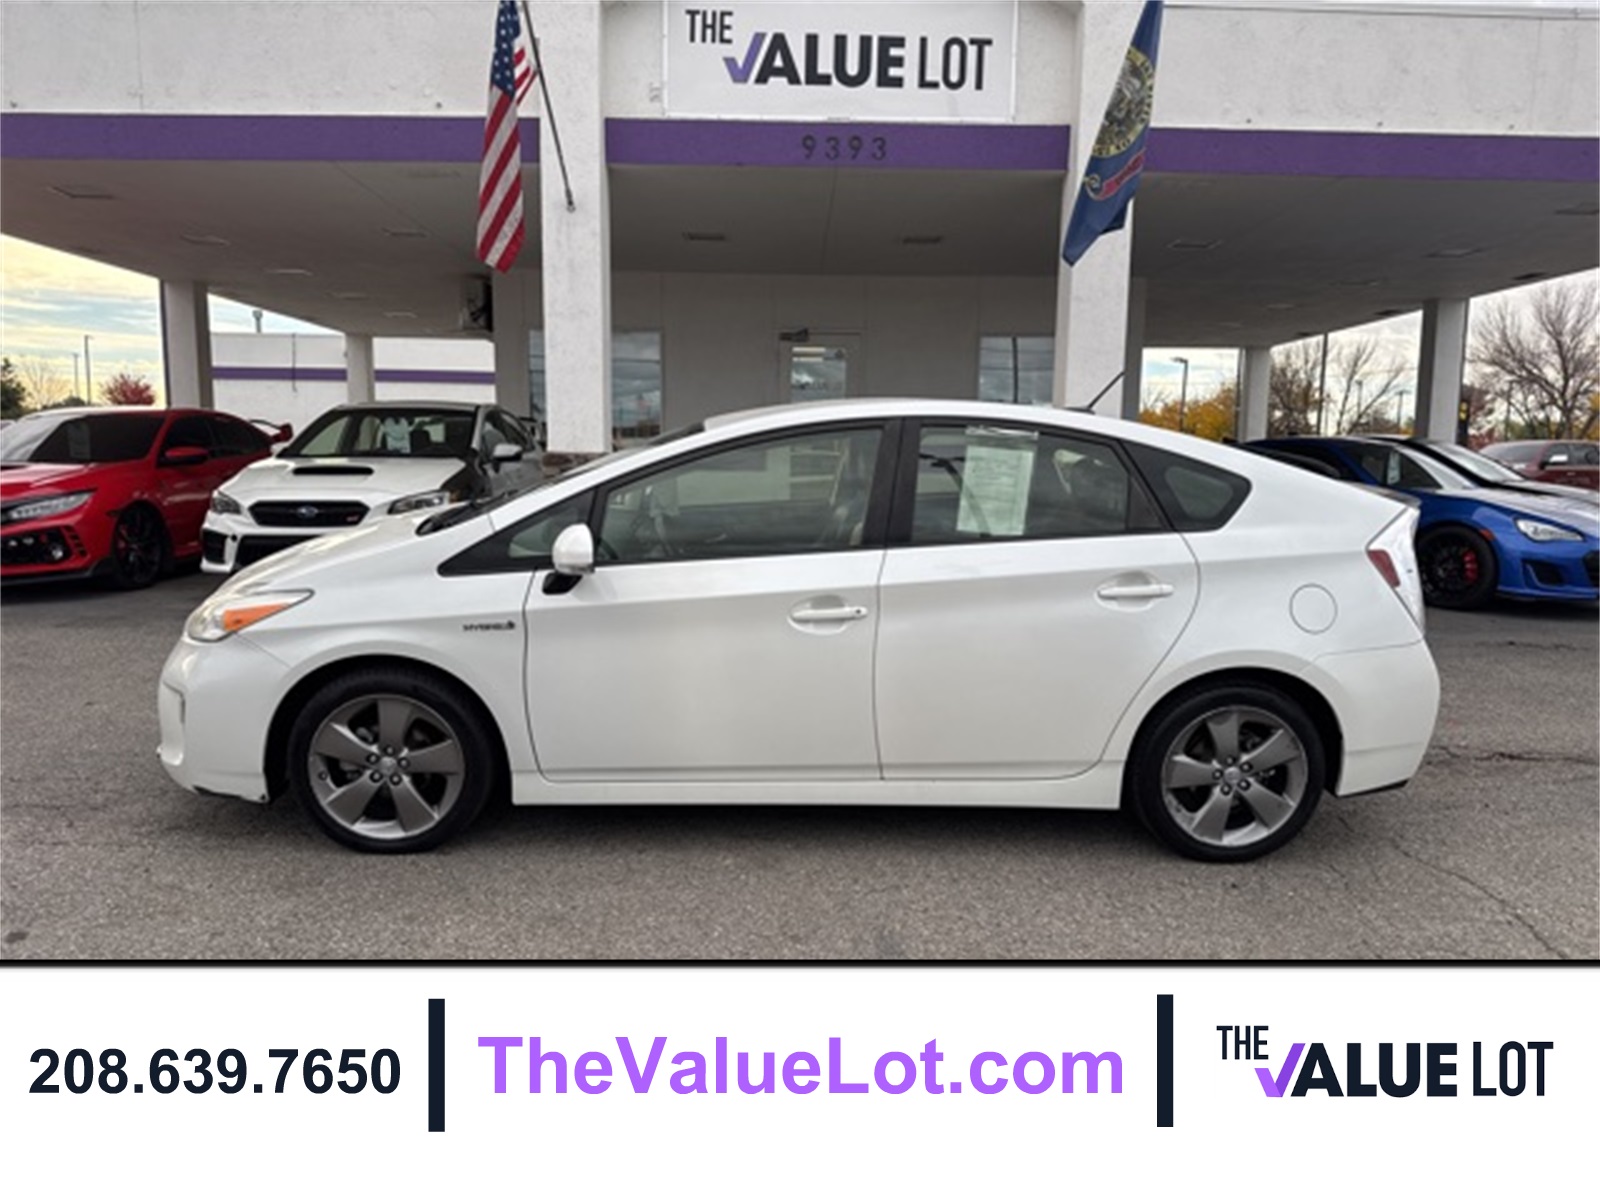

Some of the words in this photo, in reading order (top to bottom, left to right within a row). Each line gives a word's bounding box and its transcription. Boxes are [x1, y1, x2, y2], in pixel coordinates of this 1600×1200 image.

[685, 9, 734, 44] THE
[722, 32, 906, 88] VALUE
[917, 36, 993, 91] LOT
[802, 135, 887, 161] 9393
